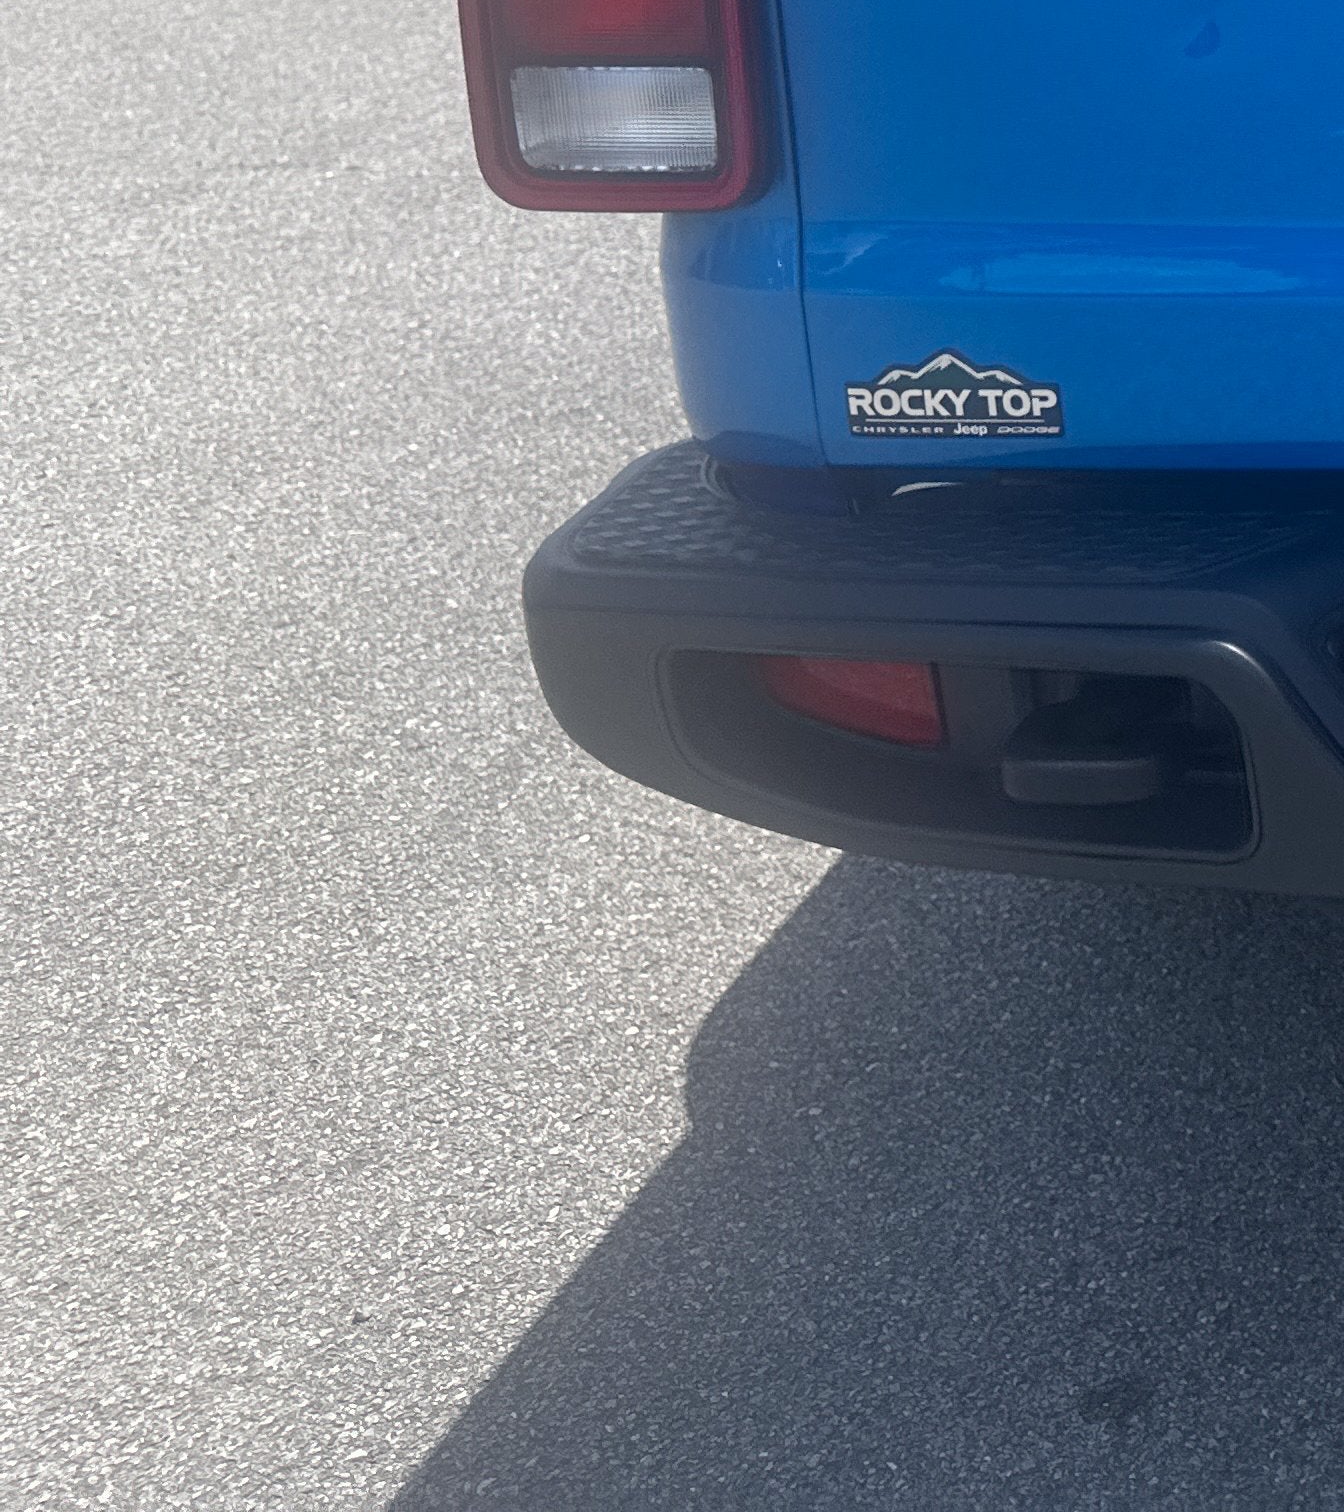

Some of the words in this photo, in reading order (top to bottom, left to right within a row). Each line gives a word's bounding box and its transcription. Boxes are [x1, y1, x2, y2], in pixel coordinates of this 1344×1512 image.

[847, 388, 972, 417] ROCKY
[978, 388, 1058, 417] TOP
[852, 425, 945, 434] CHRYSLER
[953, 423, 988, 436] Jeep
